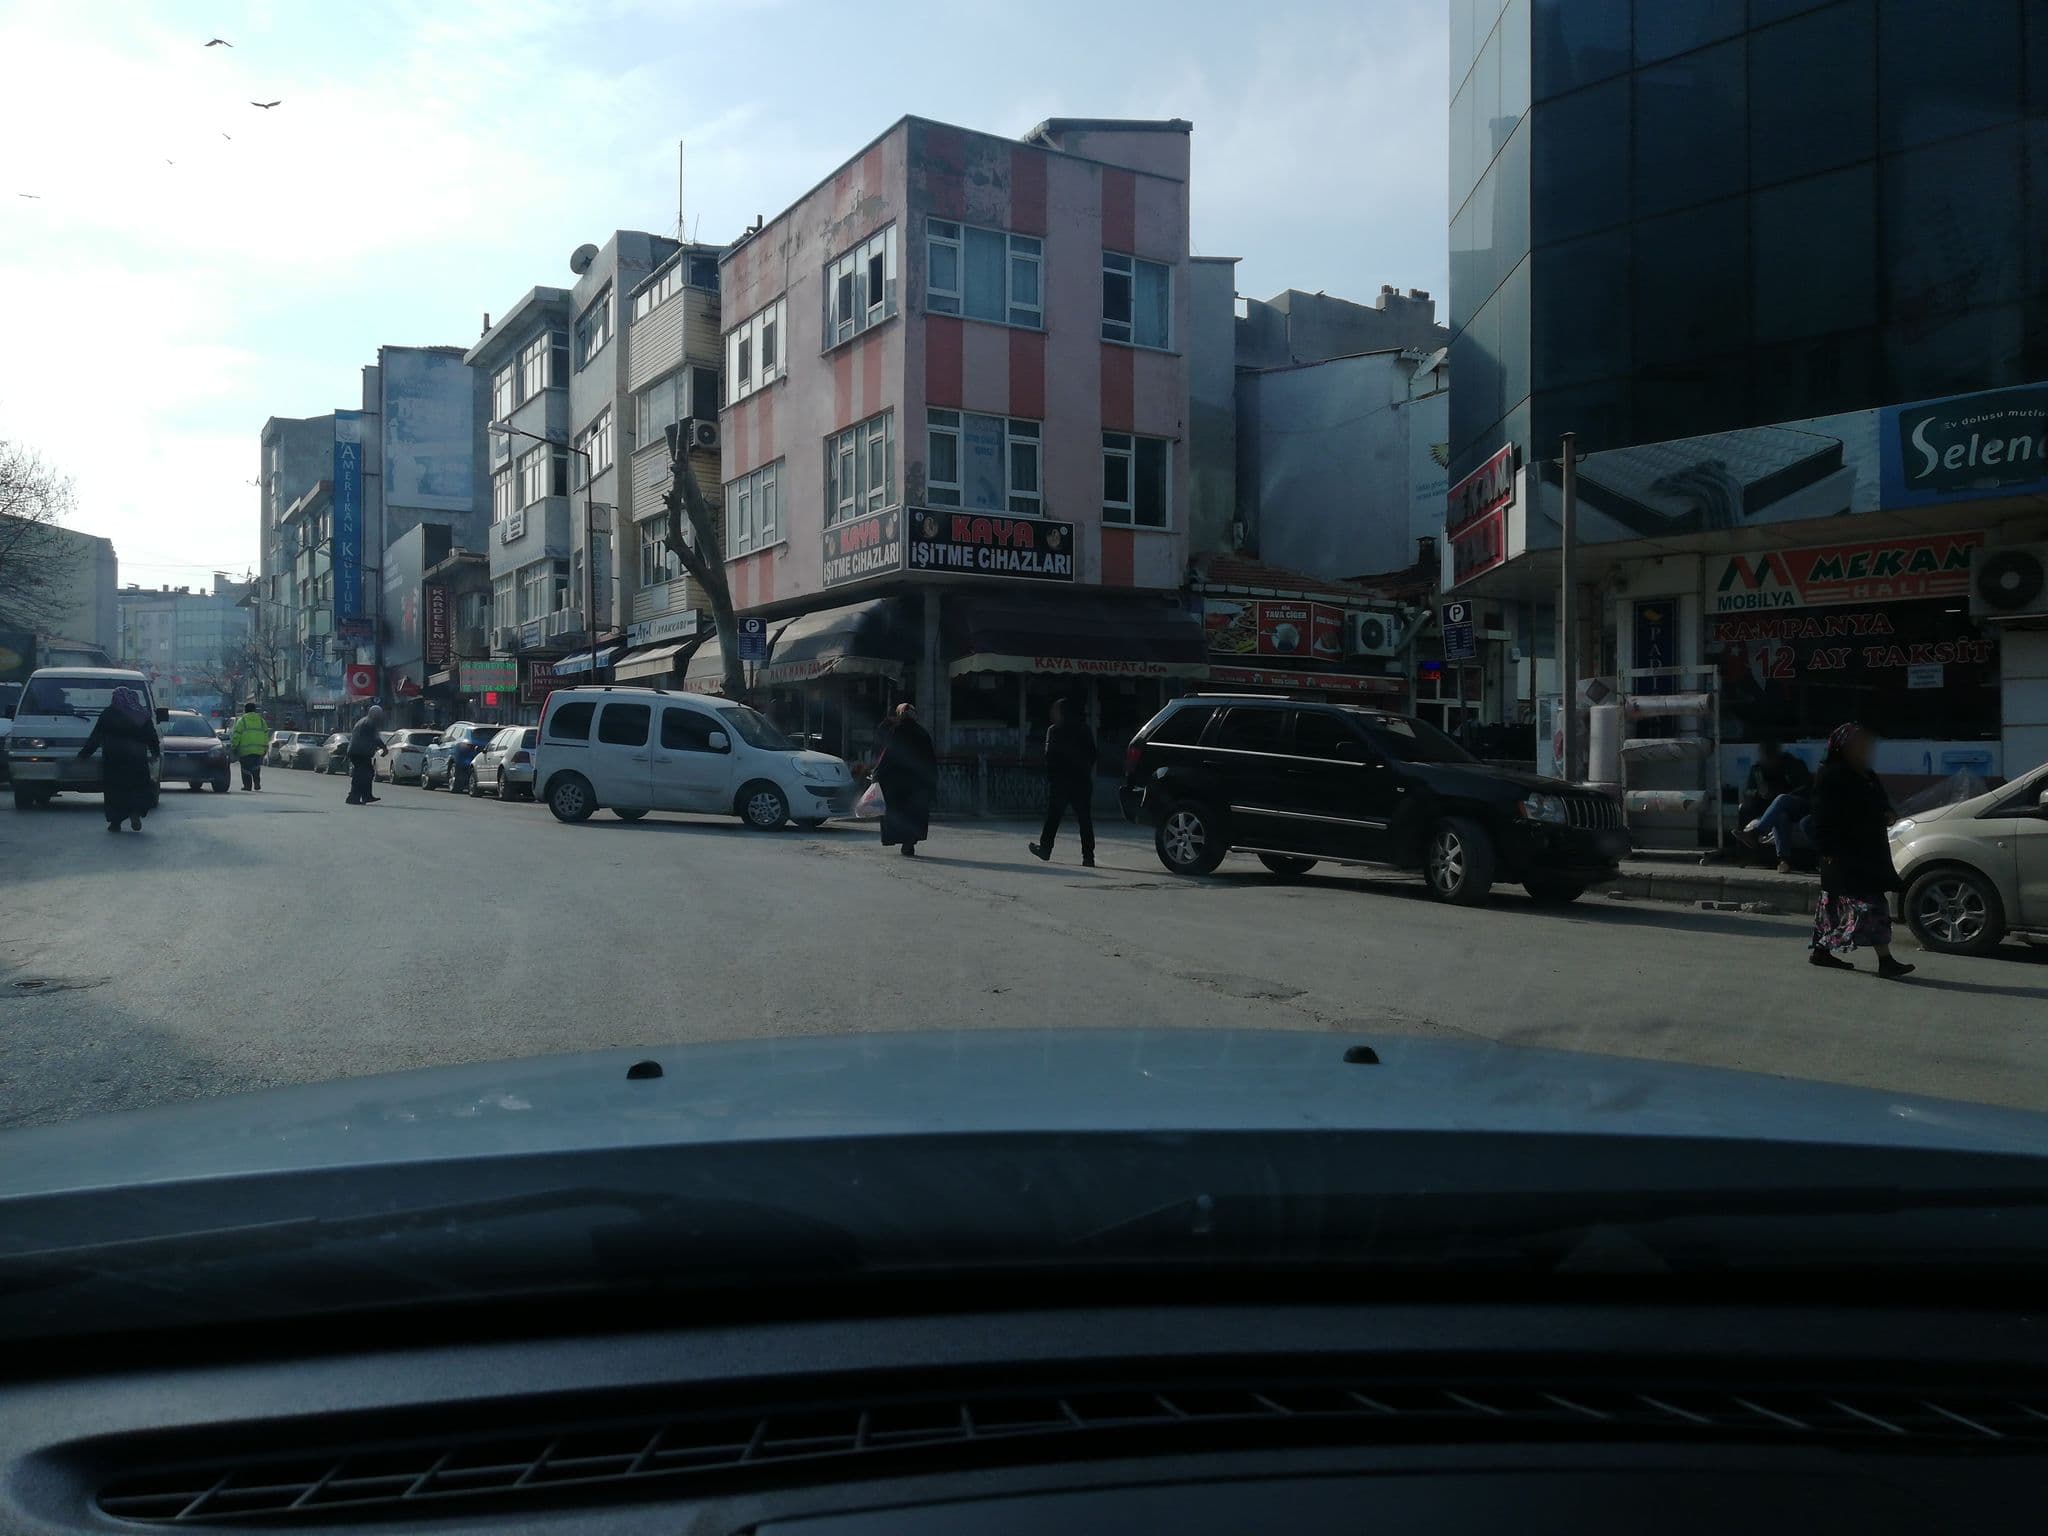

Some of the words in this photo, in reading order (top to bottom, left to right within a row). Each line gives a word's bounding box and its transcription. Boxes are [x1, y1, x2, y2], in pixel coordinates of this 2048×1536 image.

[1961, 411, 2004, 426] dolusu
[2007, 408, 2048, 418] mutlu
[840, 518, 880, 554] KAYA
[951, 514, 1034, 549] KAYA
[911, 540, 974, 568] İŞİTME
[978, 546, 1072, 575] CİHAZLARI
[1808, 543, 1976, 582] MEKAN
[1717, 591, 1796, 612] MOBİLYA
[1714, 612, 1897, 642] KAMPANYA
[1034, 656, 1073, 669] KAYA
[1755, 645, 1797, 679] 12
[1807, 647, 1852, 671] AY
[1862, 635, 1994, 668] TAKSİT
